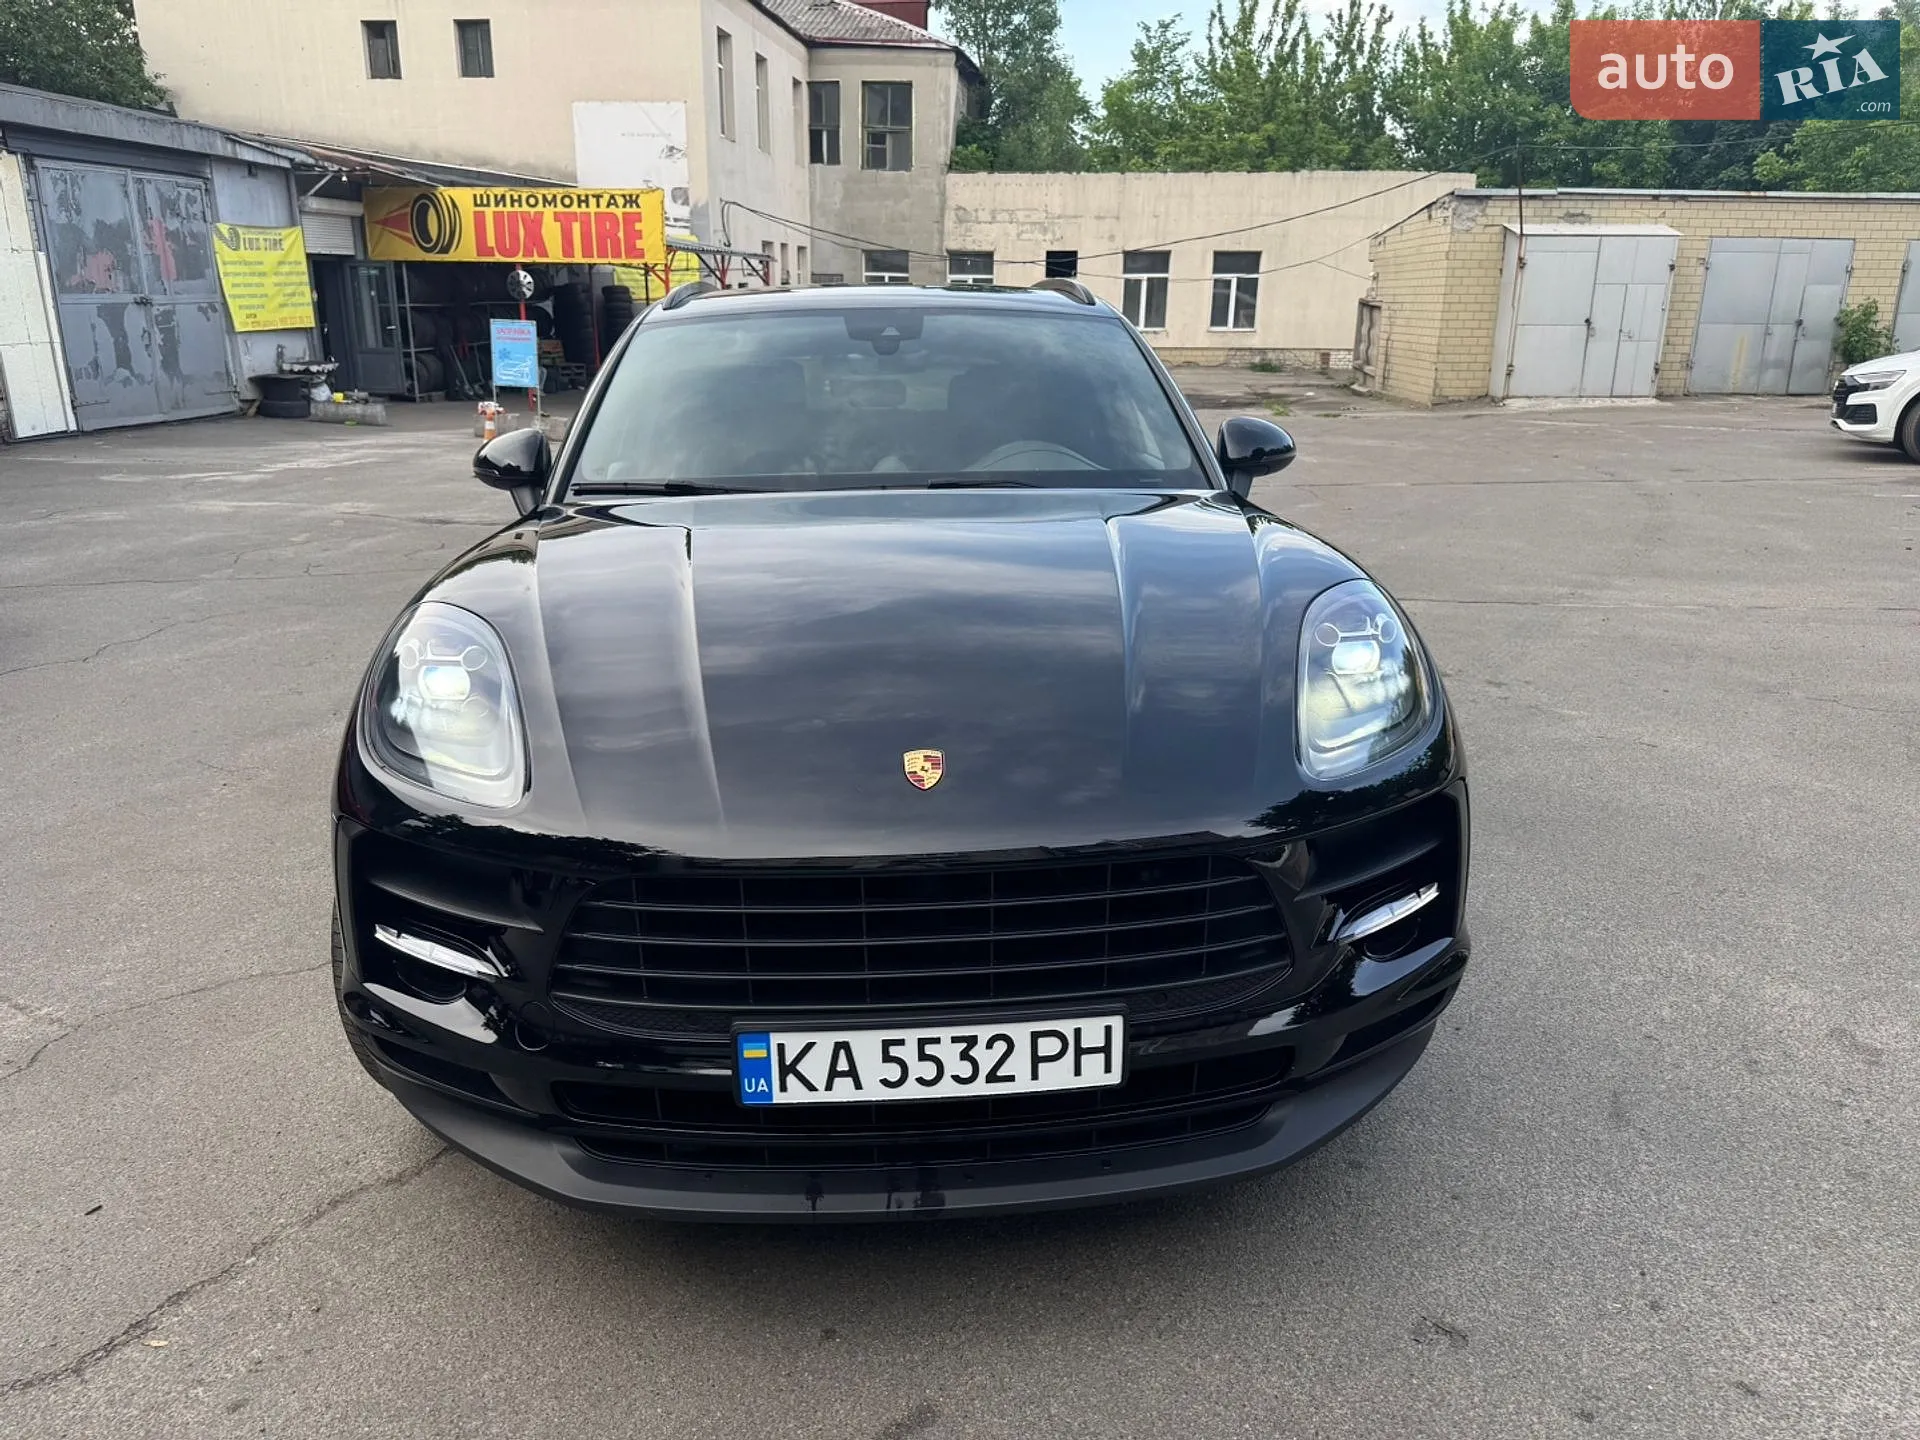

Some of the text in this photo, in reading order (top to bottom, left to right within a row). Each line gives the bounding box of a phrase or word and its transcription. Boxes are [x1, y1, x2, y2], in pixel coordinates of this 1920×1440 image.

[473, 193, 642, 209] ШИНОМОНТАЖ
[473, 210, 646, 260] LUX TIRE
[745, 1024, 1113, 1093] UA KA 5532 PH
